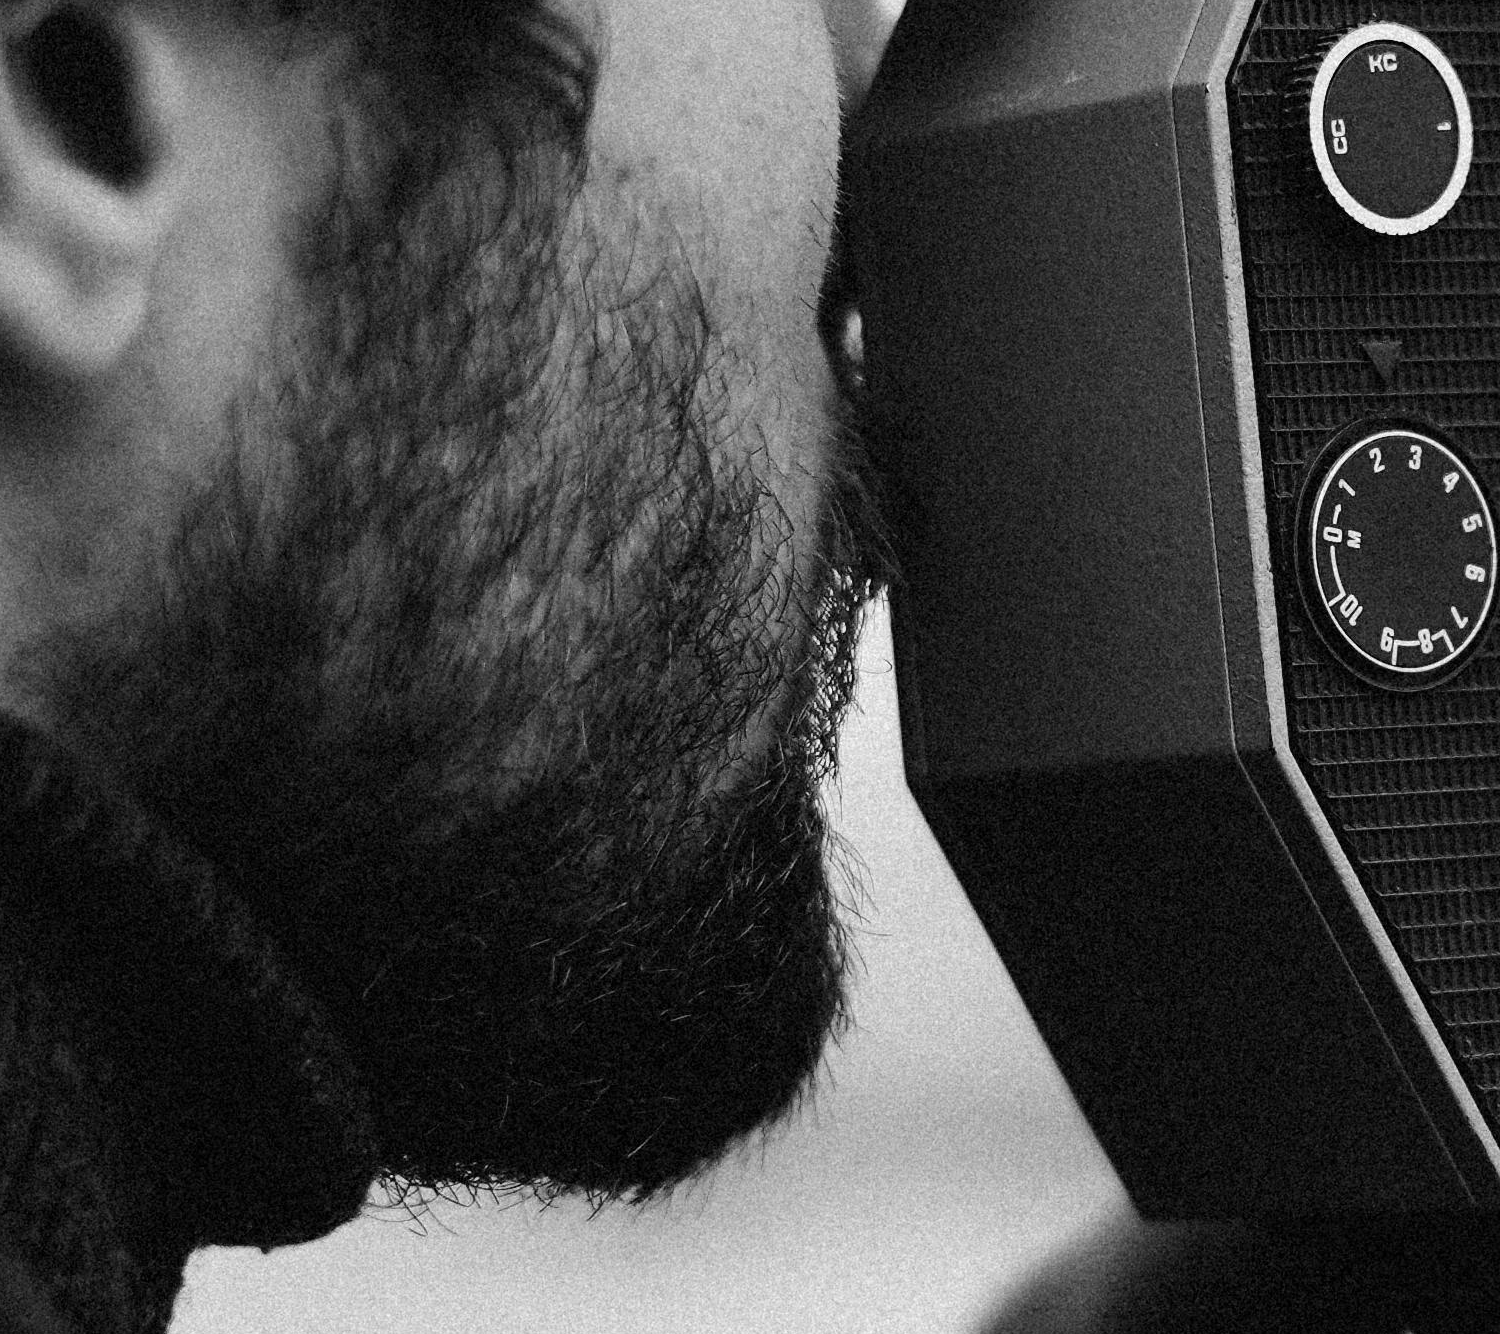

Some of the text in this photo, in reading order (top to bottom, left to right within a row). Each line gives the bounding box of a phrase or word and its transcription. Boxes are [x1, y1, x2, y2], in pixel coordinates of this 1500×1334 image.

[1368, 447, 1386, 473] 2
[1408, 444, 1423, 470] 3
[1338, 478, 1356, 497] 1
[1442, 471, 1460, 494] 4
[1461, 513, 1483, 533] 5
[1338, 593, 1364, 627] 10
[1450, 606, 1469, 629] 7
[1417, 628, 1435, 654] 8
